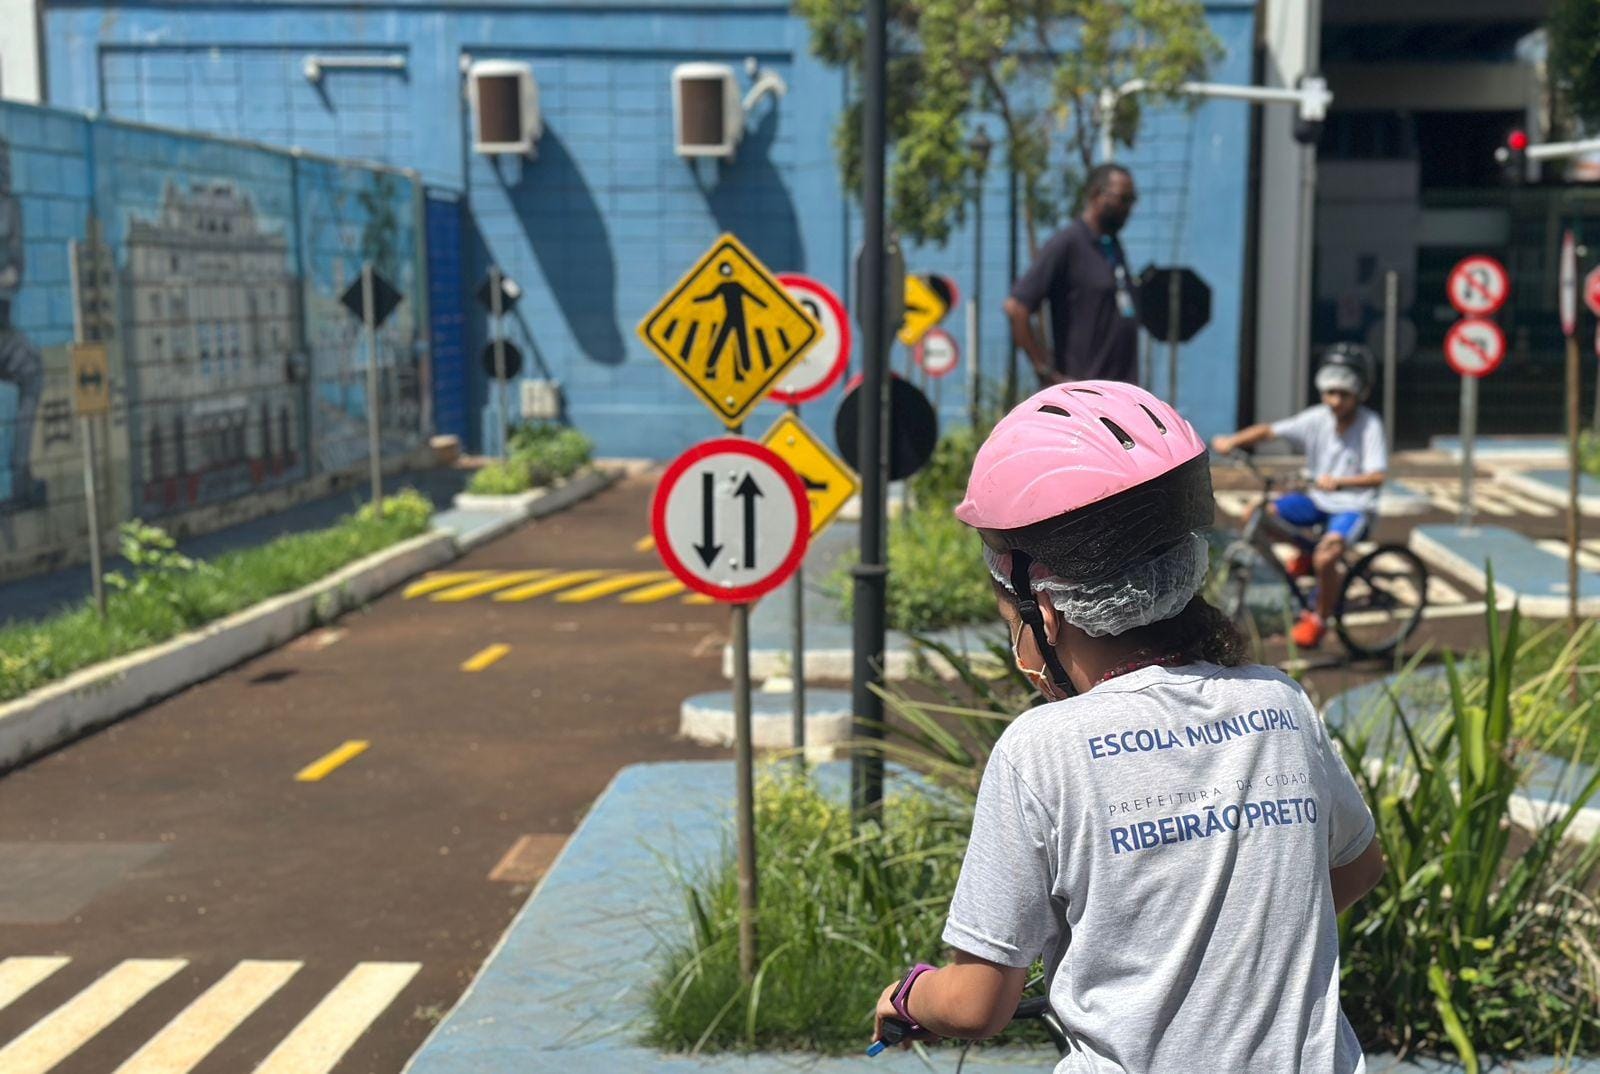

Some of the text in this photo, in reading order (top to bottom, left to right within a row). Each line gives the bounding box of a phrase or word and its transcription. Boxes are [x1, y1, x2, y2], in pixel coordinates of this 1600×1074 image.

[1088, 708, 1299, 759] ESCOLA MUNICIPAL
[1109, 787, 1222, 816] PREFEITURA
[1236, 779, 1252, 791] DA
[1110, 797, 1317, 854] RIBEIRÃO PRETO
